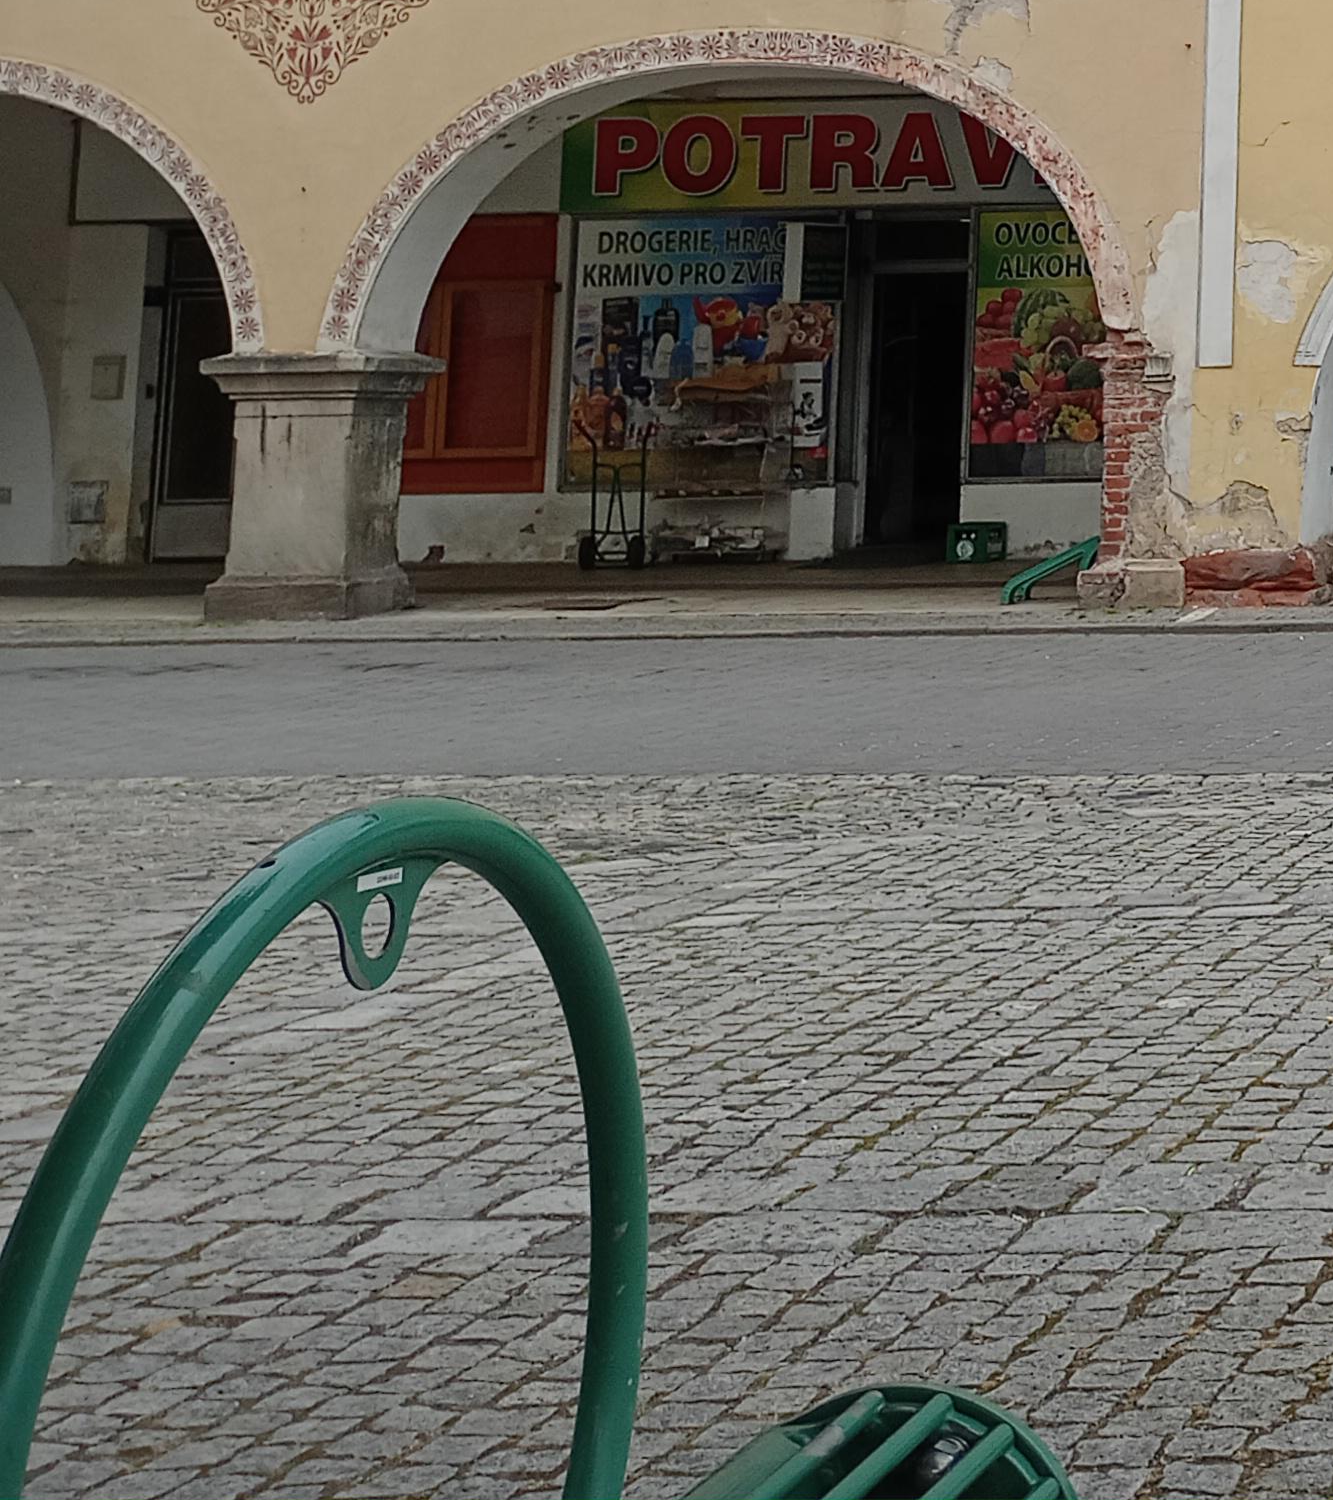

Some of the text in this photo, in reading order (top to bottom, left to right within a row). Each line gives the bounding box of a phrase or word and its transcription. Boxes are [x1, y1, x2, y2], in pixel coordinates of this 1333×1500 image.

[593, 112, 1047, 196] POTRAV
[599, 230, 718, 255] DROGERIE,
[583, 262, 673, 287] KRMIVO
[680, 262, 725, 285] PRO
